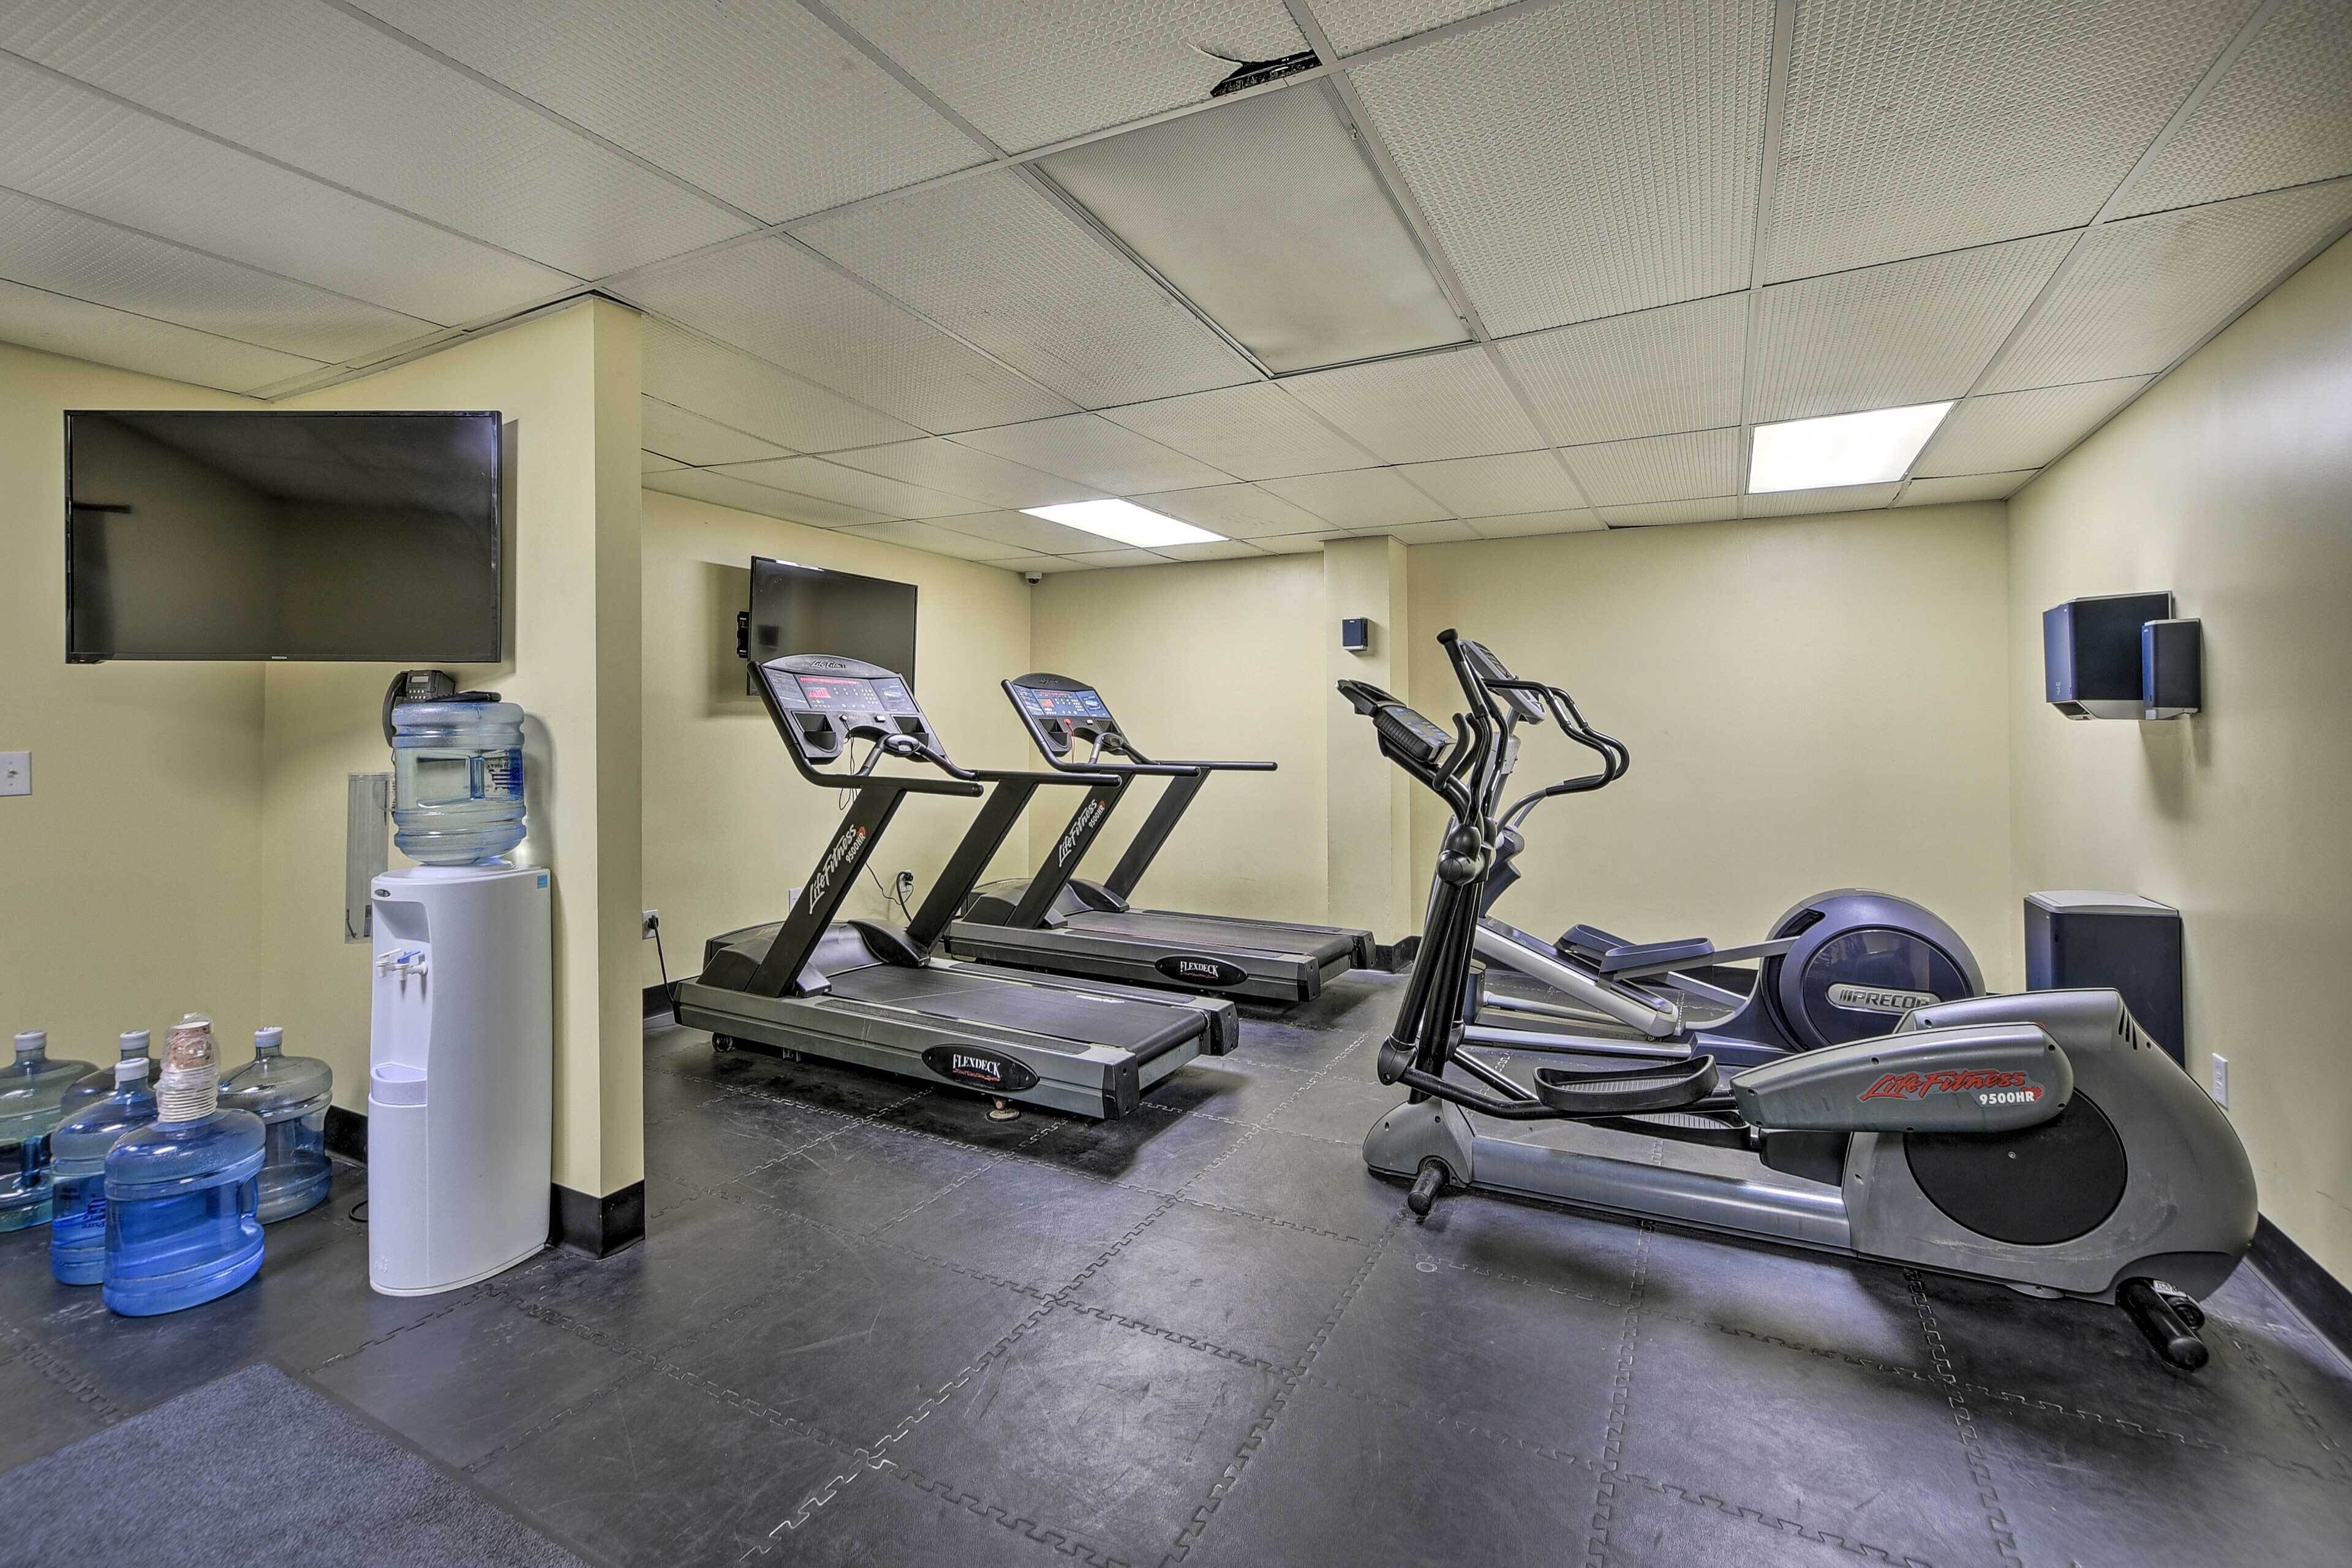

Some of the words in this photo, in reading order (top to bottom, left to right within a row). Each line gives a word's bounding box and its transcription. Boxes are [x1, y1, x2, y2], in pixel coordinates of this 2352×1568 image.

[1088, 805, 1105, 828] 9500HR
[845, 832, 866, 864] 9500HR
[1180, 960, 1219, 978] FLEXDECK
[952, 1054, 1001, 1079] FLEXDECK
[1979, 1090, 2035, 1105] 9500HR
